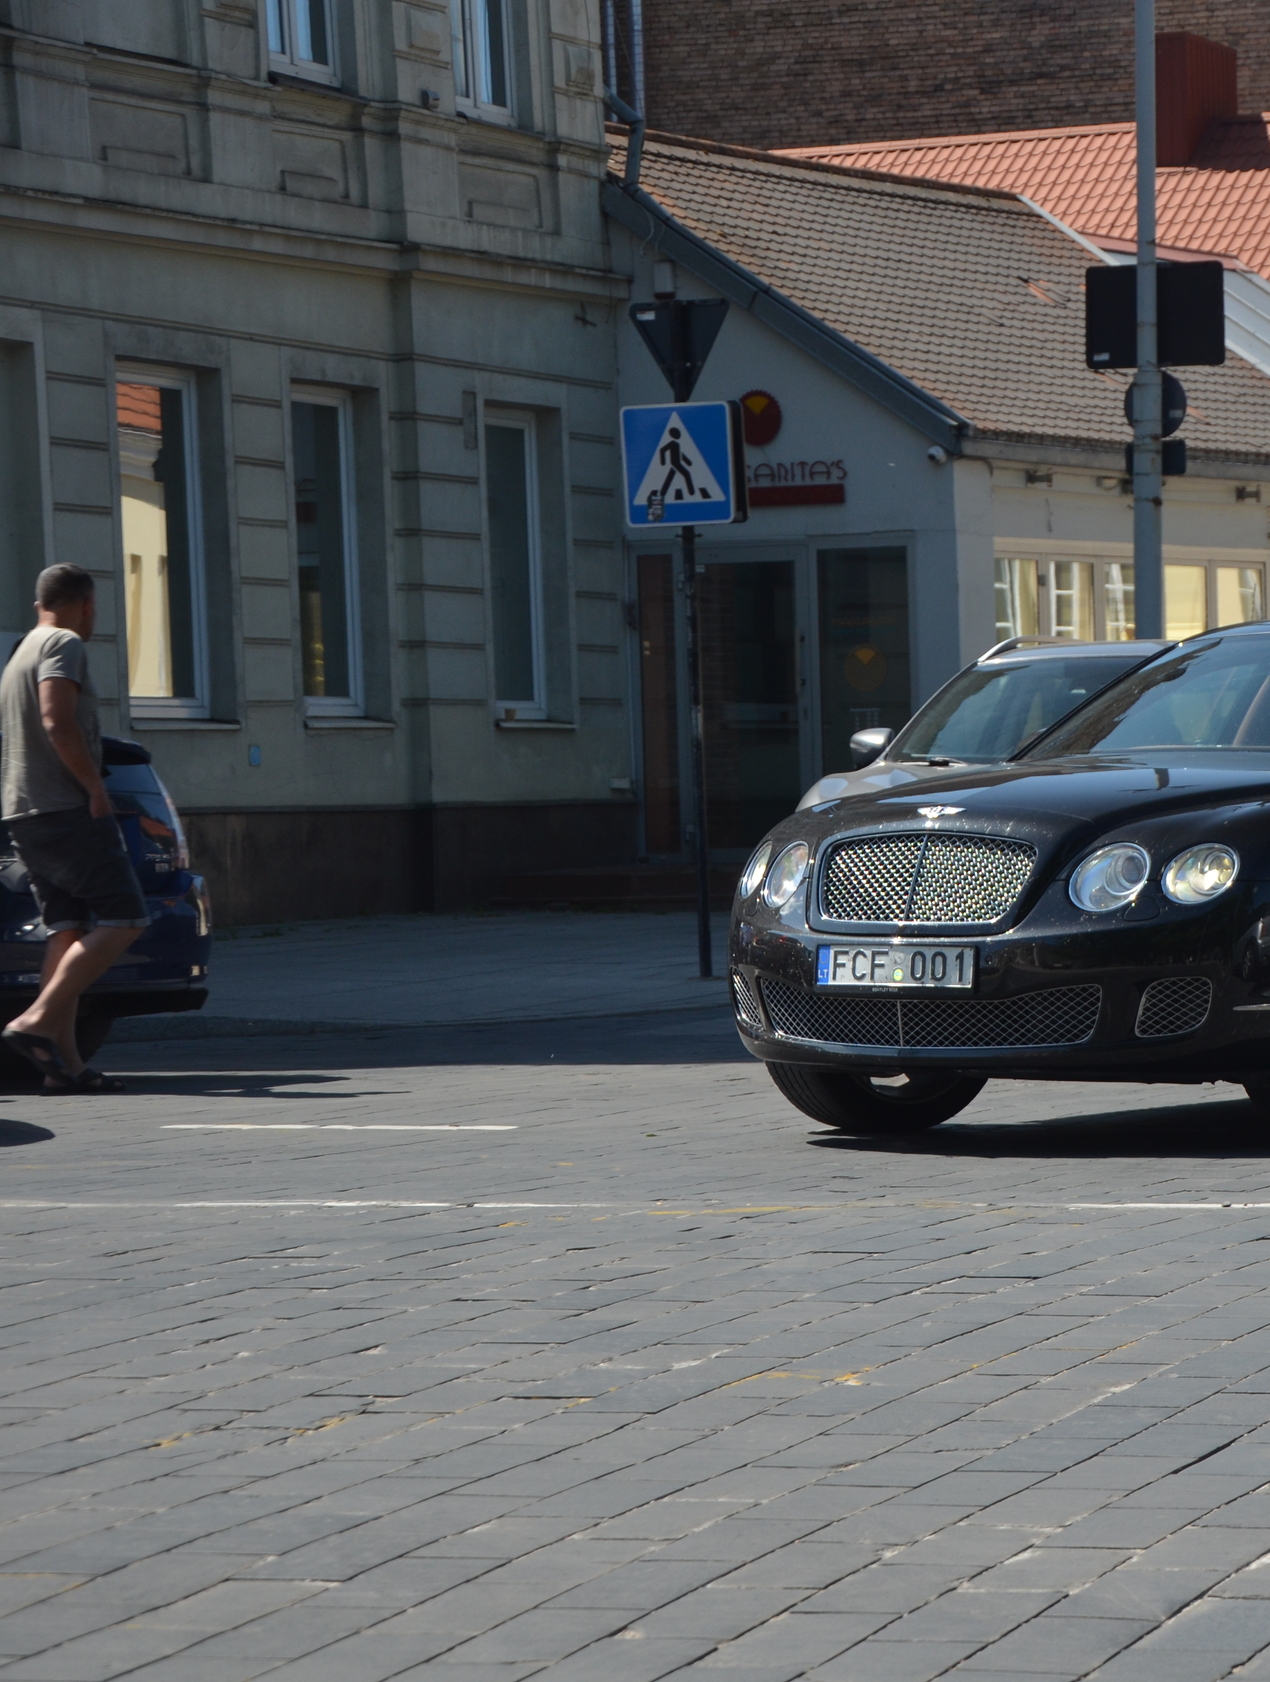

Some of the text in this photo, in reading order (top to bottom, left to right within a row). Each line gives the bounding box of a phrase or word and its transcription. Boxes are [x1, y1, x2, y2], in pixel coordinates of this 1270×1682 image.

[817, 968, 829, 979] LT
[832, 949, 965, 982] FCF 001
